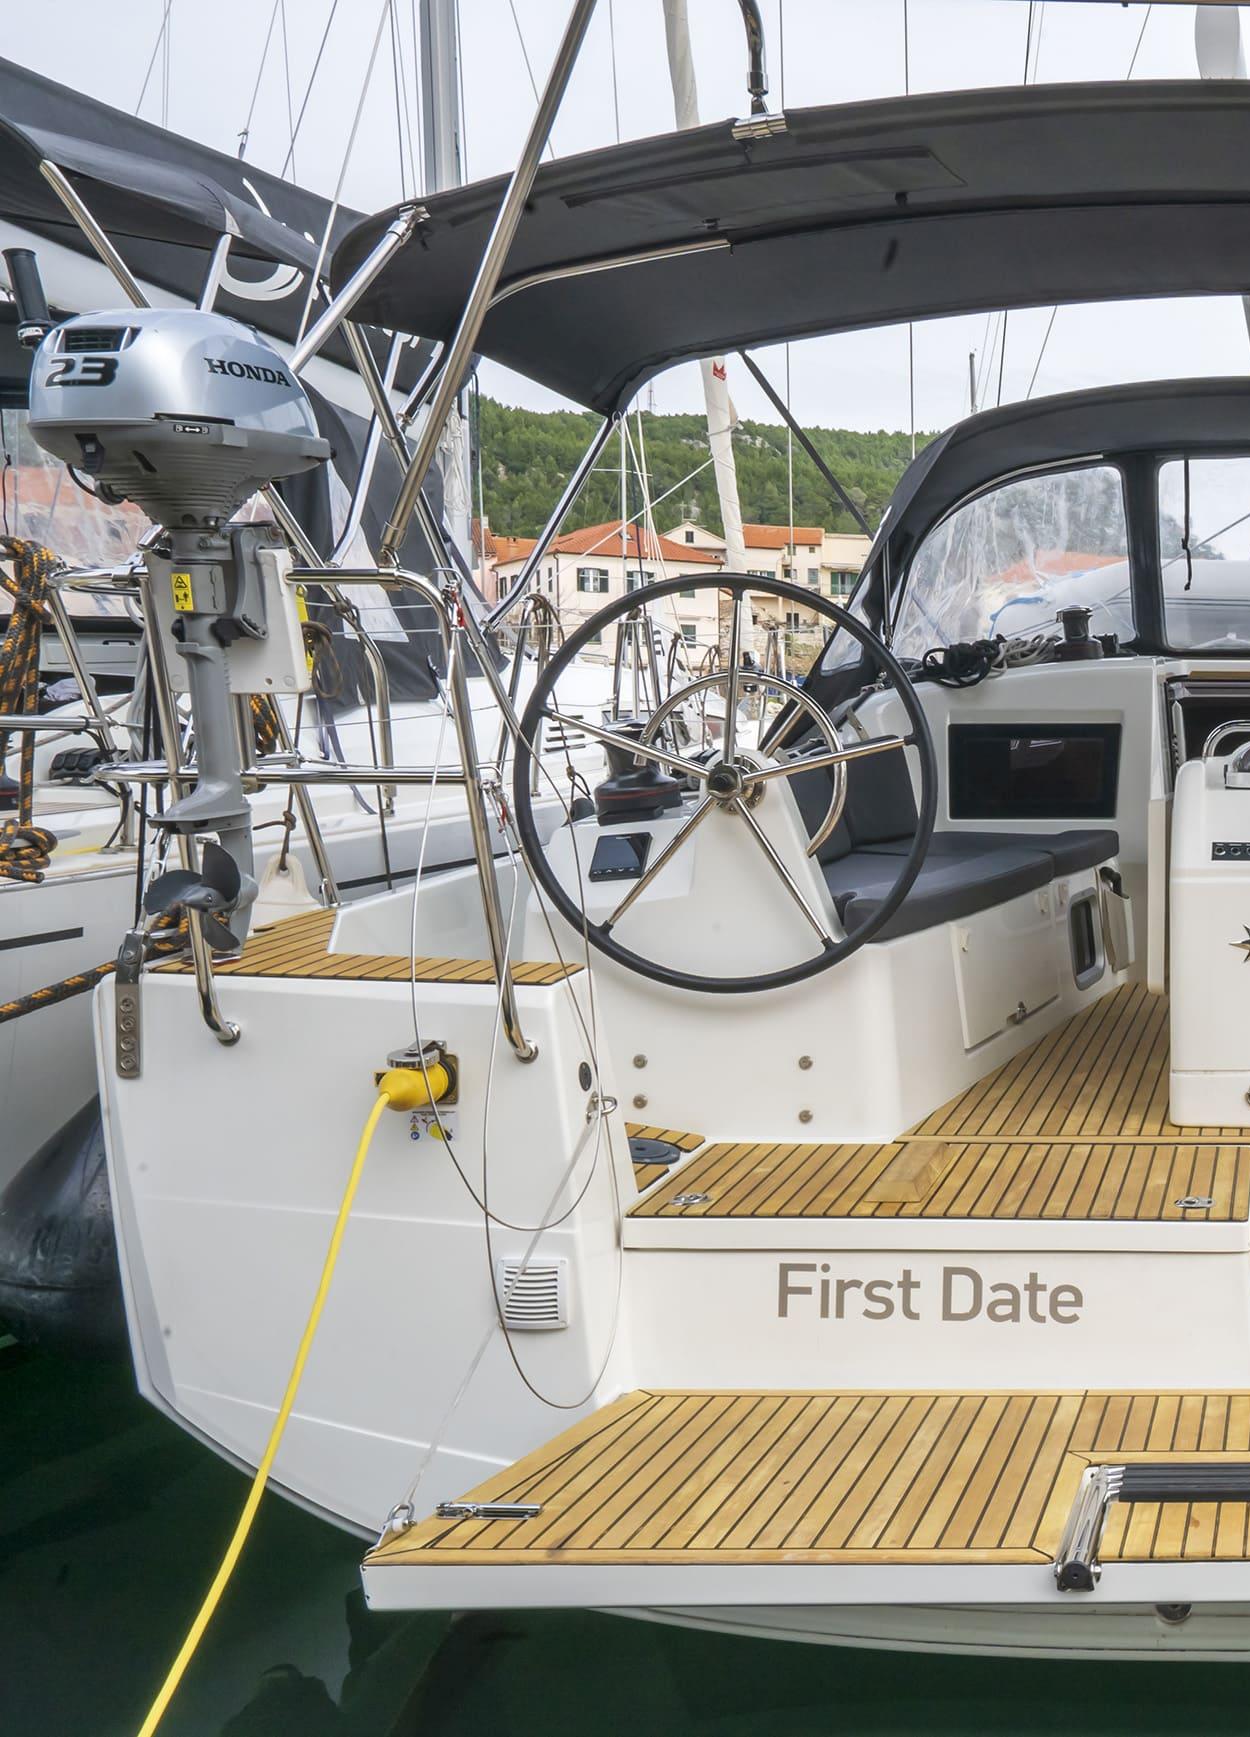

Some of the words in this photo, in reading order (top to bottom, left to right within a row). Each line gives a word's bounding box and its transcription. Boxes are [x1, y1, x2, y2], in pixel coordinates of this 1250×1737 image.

[203, 357, 291, 388] HONDA
[778, 1262, 921, 1321] First
[942, 1266, 1084, 1325] Date
